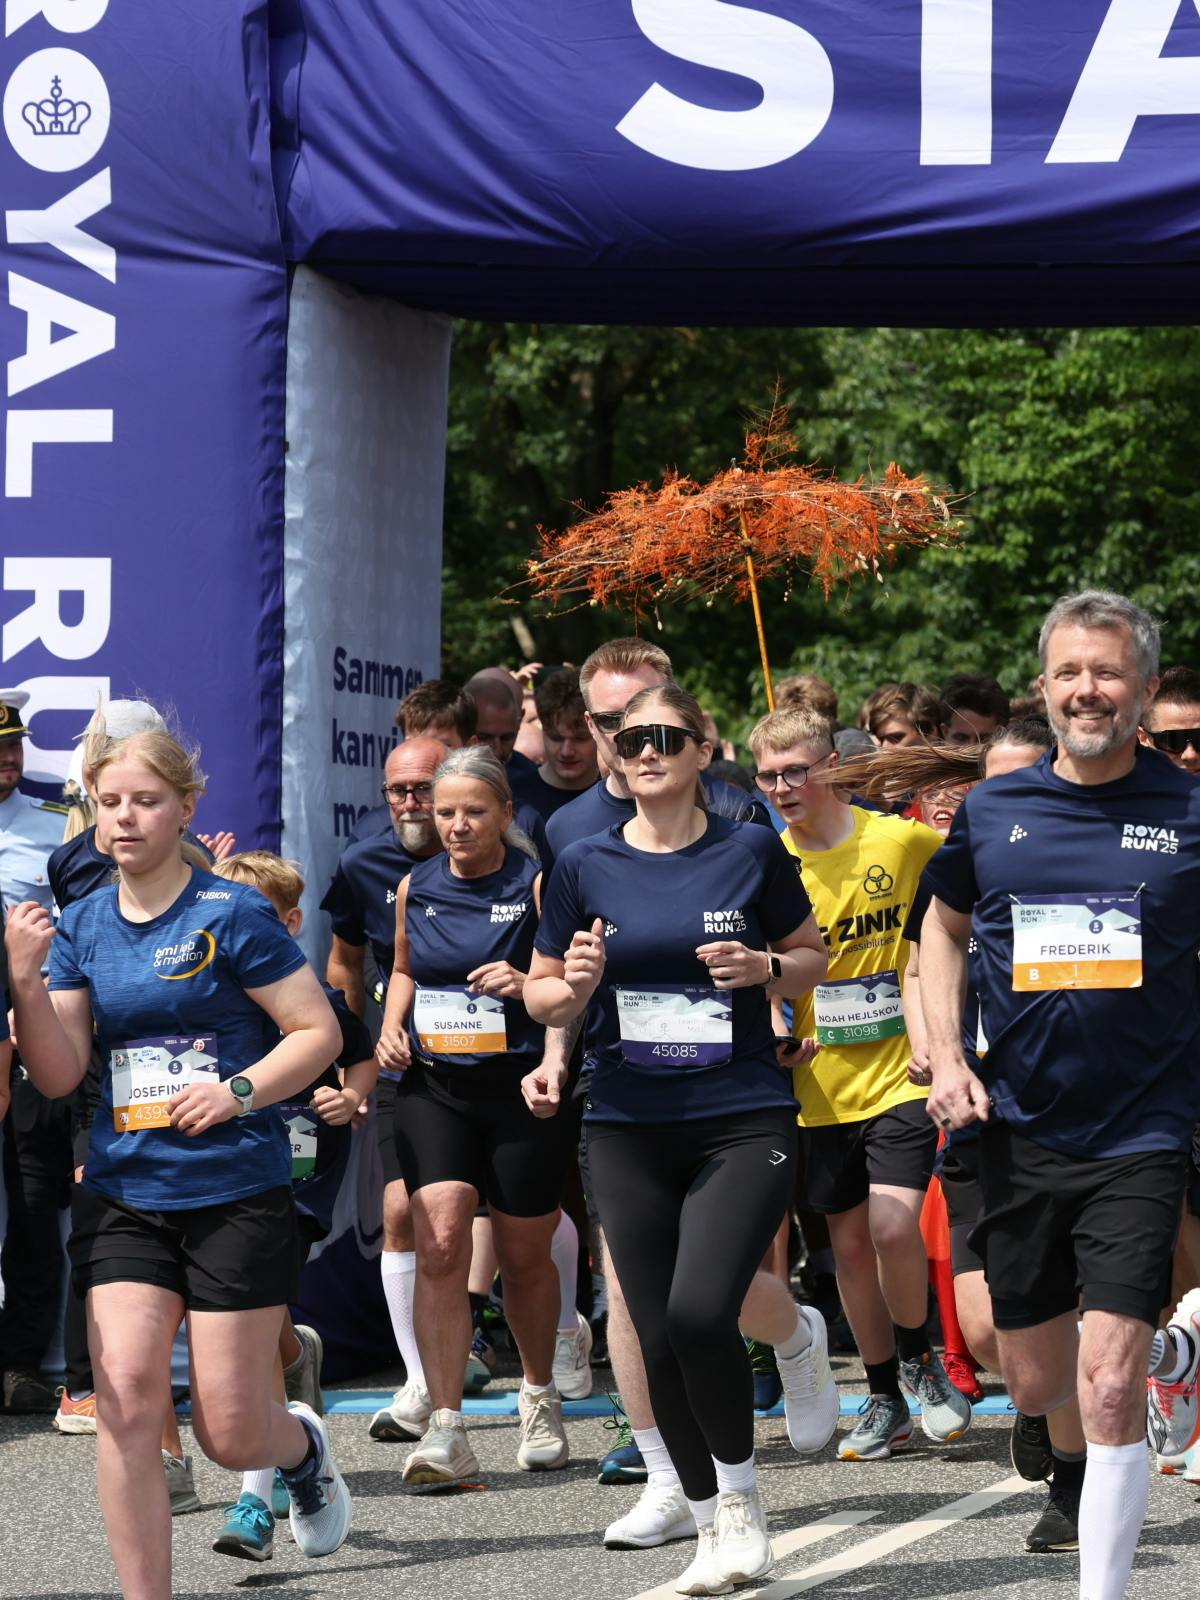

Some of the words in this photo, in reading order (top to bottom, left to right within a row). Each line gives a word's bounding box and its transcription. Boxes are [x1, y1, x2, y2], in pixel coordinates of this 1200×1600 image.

[1122, 823, 1180, 843] ROYAL
[196, 890, 232, 900] FUSION
[703, 909, 744, 922] ROYAL
[155, 944, 178, 958] bmi
[1040, 944, 1111, 956] FREDERIK
[1029, 968, 1040, 981] B
[818, 1015, 845, 1023] NOAH
[848, 1004, 899, 1021] HEJLSKOV
[434, 1021, 483, 1030] SUSANNE
[827, 1031, 835, 1039] C
[842, 1024, 879, 1039] 31098
[442, 1035, 476, 1047] 31507
[652, 1045, 698, 1058] 45085
